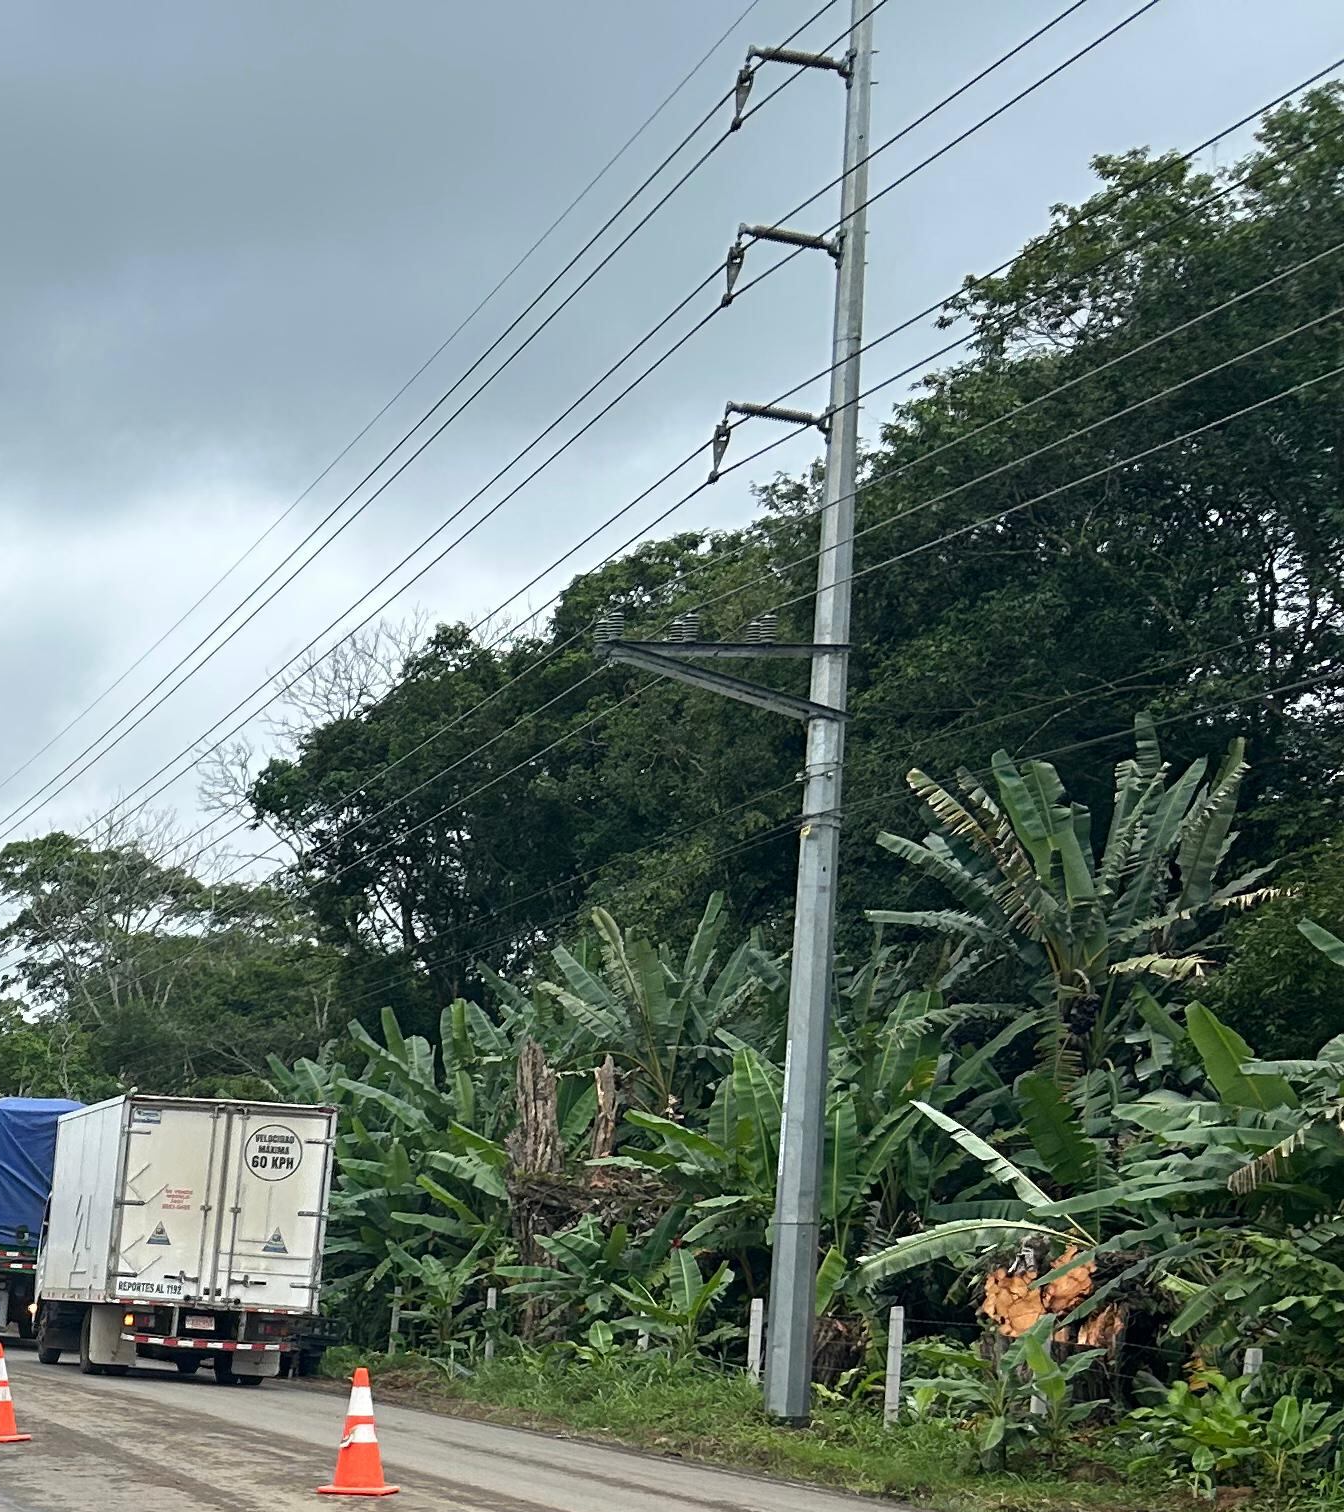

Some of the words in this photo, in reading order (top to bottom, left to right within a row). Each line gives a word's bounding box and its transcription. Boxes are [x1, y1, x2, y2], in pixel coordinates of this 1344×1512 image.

[255, 1134, 295, 1144] VELOCIDAD
[251, 1155, 267, 1169] 60
[270, 1156, 294, 1170] KPH
[118, 1281, 154, 1293] REPORTES
[155, 1284, 164, 1294] AL
